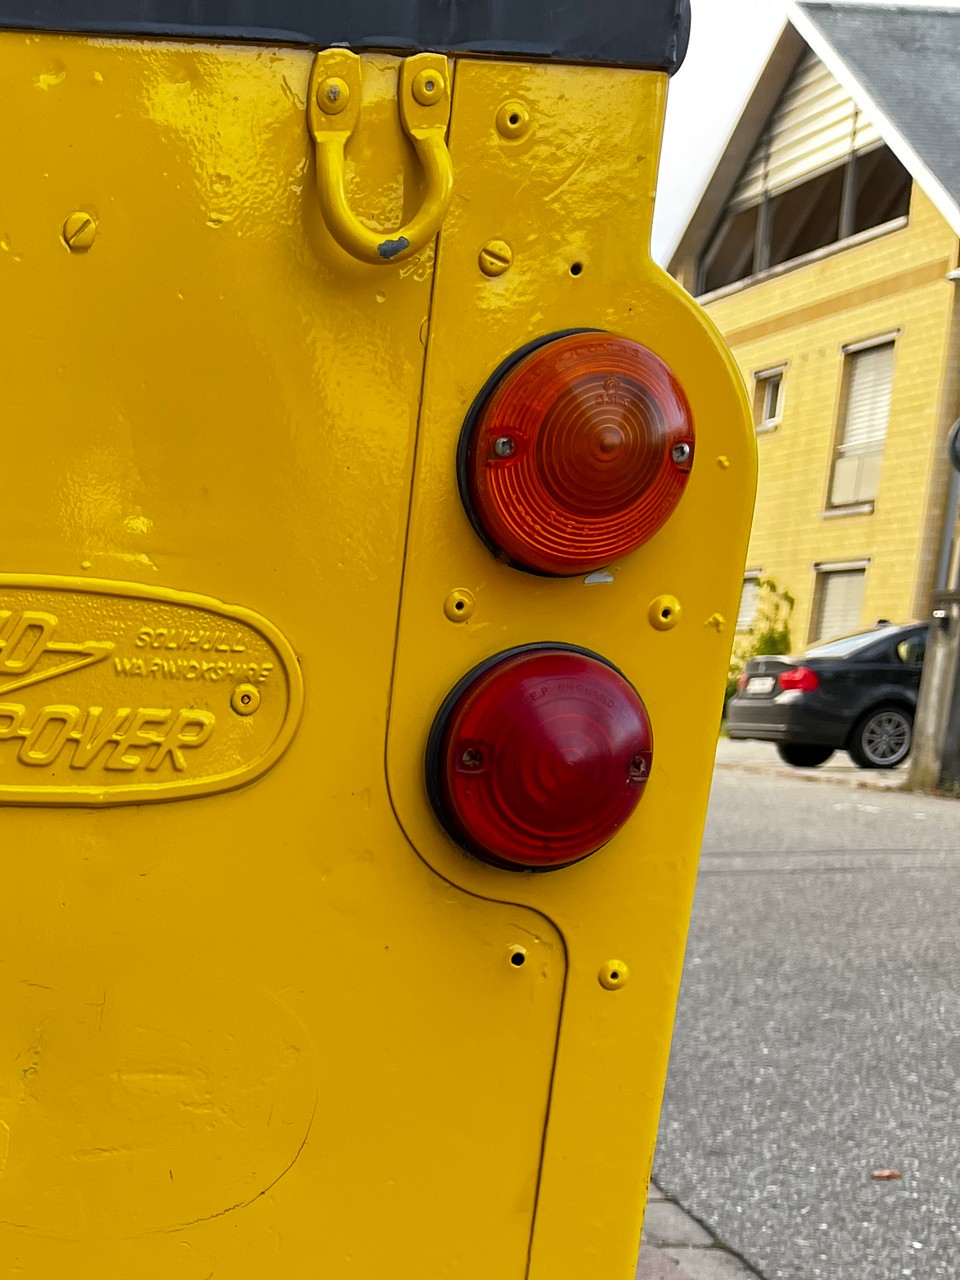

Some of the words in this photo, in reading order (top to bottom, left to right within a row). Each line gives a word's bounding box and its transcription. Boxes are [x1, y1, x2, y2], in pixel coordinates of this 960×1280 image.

[133, 626, 247, 654] SOLIHULL
[114, 656, 274, 684] WARWICKSHIRE
[557, 683, 616, 709] ENGLAND
